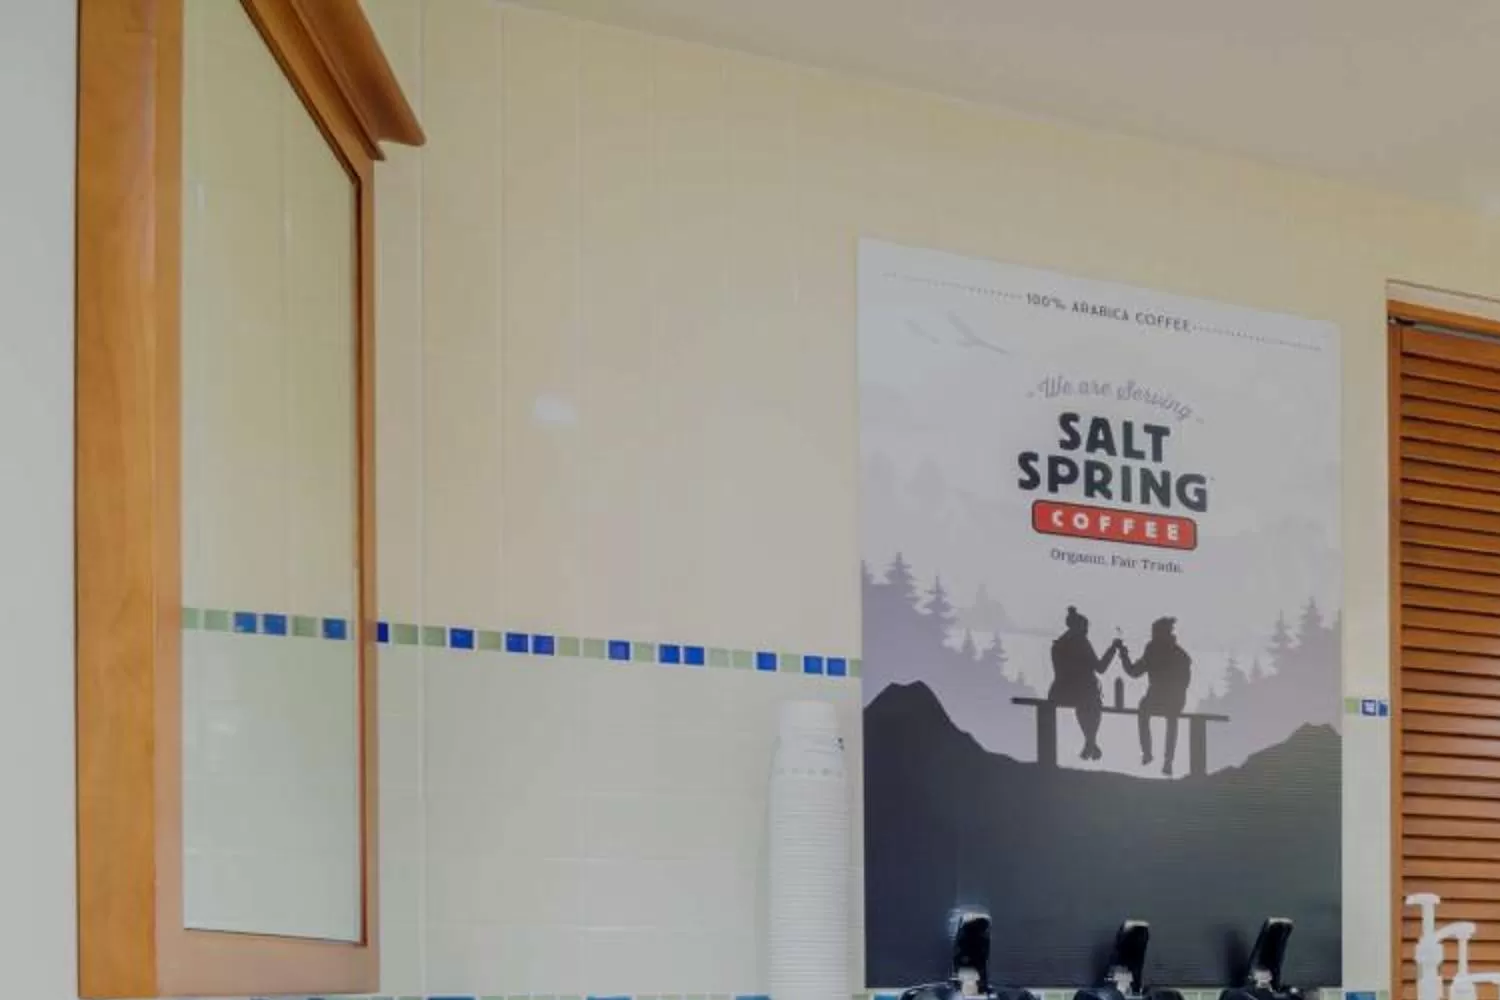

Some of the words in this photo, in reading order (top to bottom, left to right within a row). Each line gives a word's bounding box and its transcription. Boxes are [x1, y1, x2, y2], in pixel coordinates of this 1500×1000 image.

[1027, 292, 1067, 310] 100%
[1072, 300, 1129, 321] ARABICA
[1135, 311, 1191, 333] COFFEE
[1036, 374, 1072, 399] We
[1079, 380, 1110, 396] are
[1116, 380, 1193, 421] Serving
[1058, 411, 1170, 463] SALT
[1017, 451, 1208, 512] SPRING
[1051, 509, 1180, 541] COFFEE
[1050, 547, 1107, 566] Organic.
[1111, 554, 1138, 569] Fair
[1142, 558, 1184, 574] Trade.
